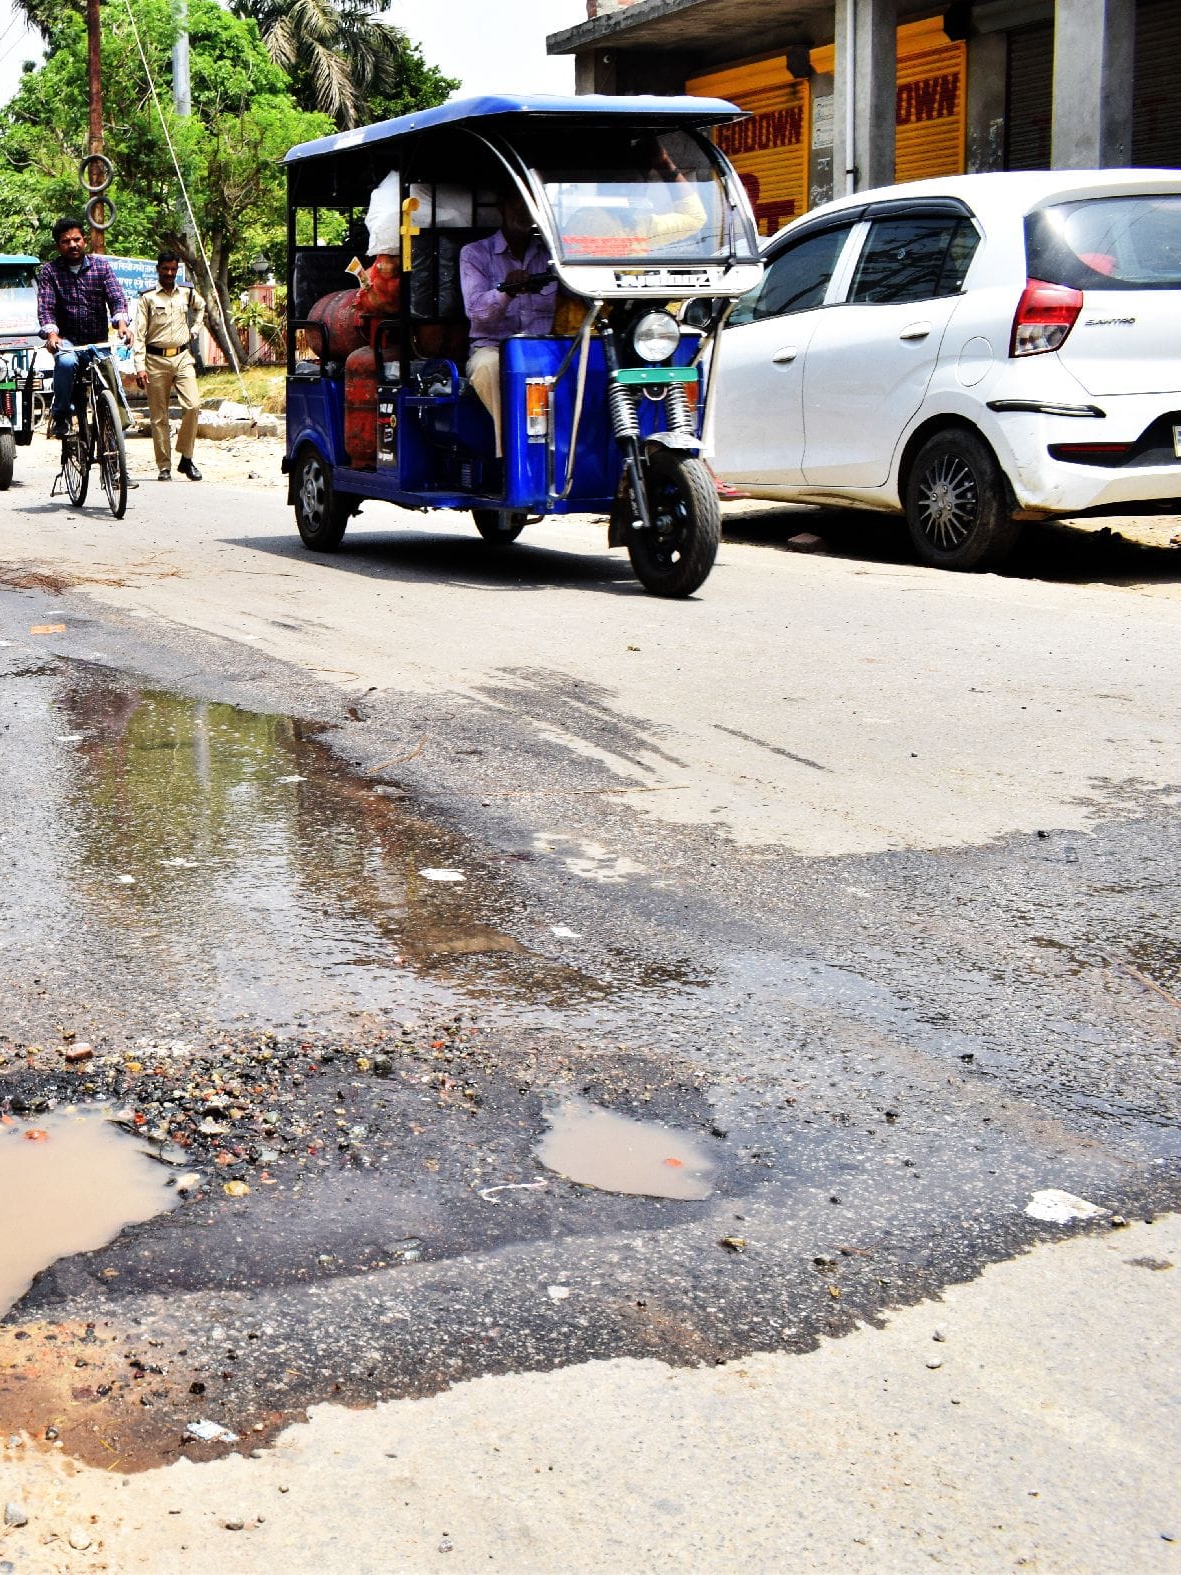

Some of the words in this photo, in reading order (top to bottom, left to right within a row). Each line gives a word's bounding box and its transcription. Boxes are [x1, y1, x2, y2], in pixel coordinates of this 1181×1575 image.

[895, 73, 959, 125] OWN
[716, 104, 804, 154] GODOWN
[1085, 317, 1136, 326] SANTRO
